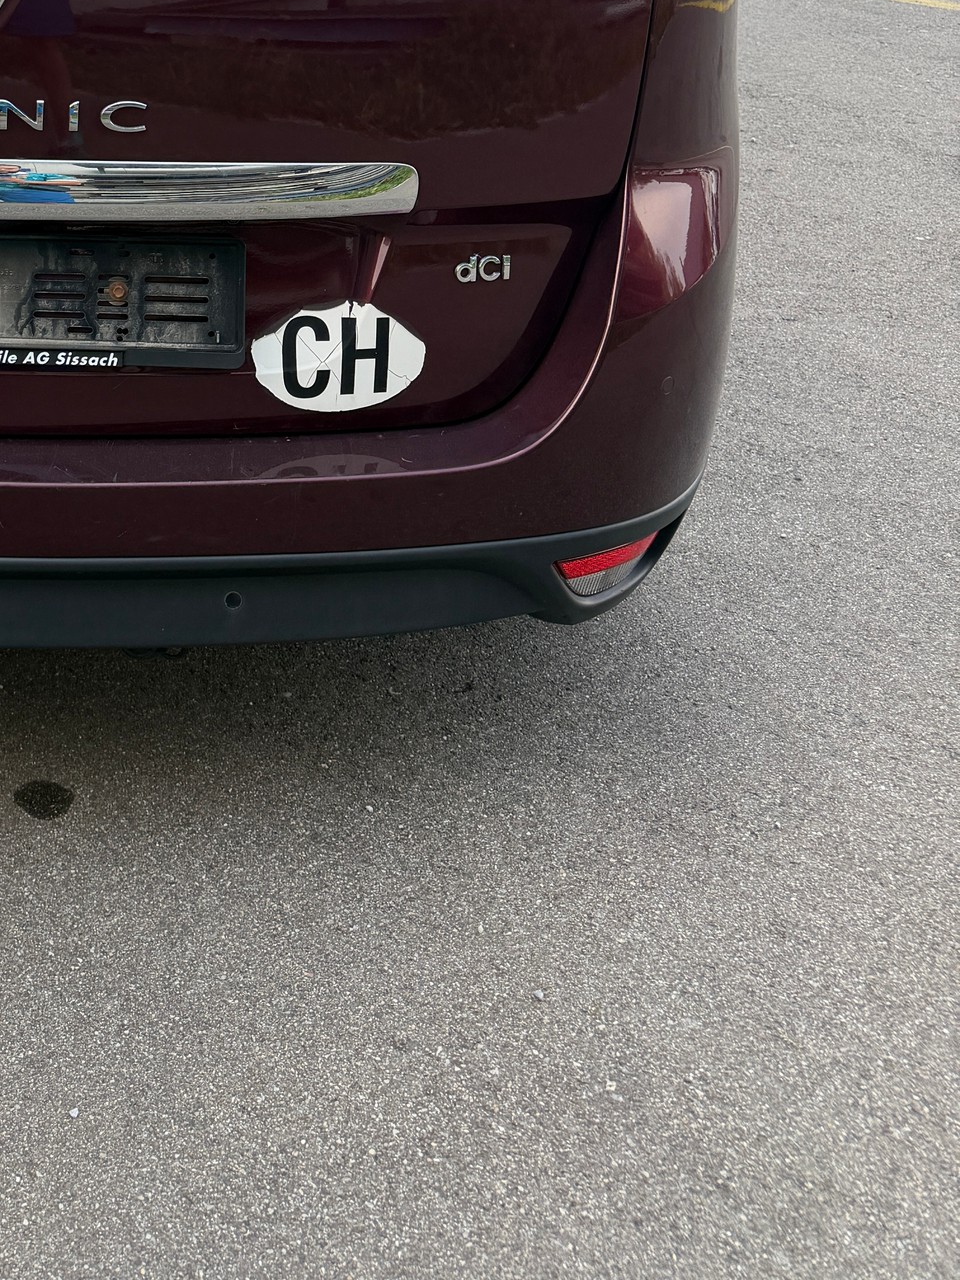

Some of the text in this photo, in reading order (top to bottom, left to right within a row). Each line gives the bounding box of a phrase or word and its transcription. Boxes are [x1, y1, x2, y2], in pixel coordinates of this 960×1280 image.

[22, 351, 50, 365] AG
[55, 351, 119, 367] Sissach
[281, 315, 390, 399] CH
